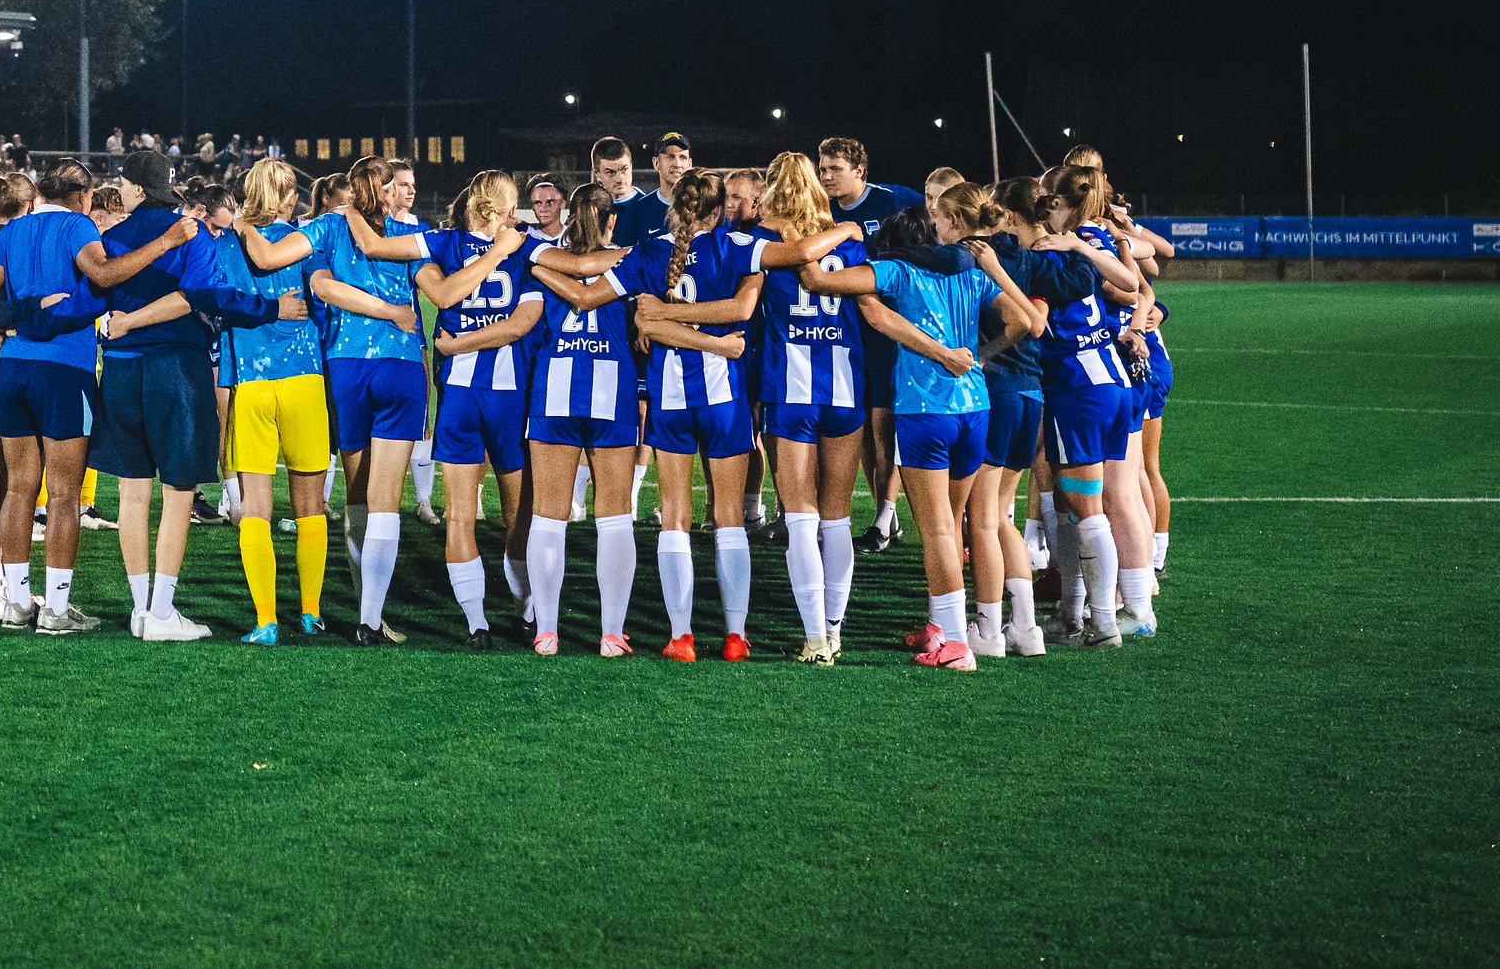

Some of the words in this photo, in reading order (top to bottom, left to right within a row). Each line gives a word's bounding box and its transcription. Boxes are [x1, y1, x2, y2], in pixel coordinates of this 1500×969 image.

[1346, 233, 1360, 244] IM
[1363, 232, 1458, 245] MITTELPUNKT
[806, 326, 843, 340] HYGH
[570, 338, 610, 353] HYGH
